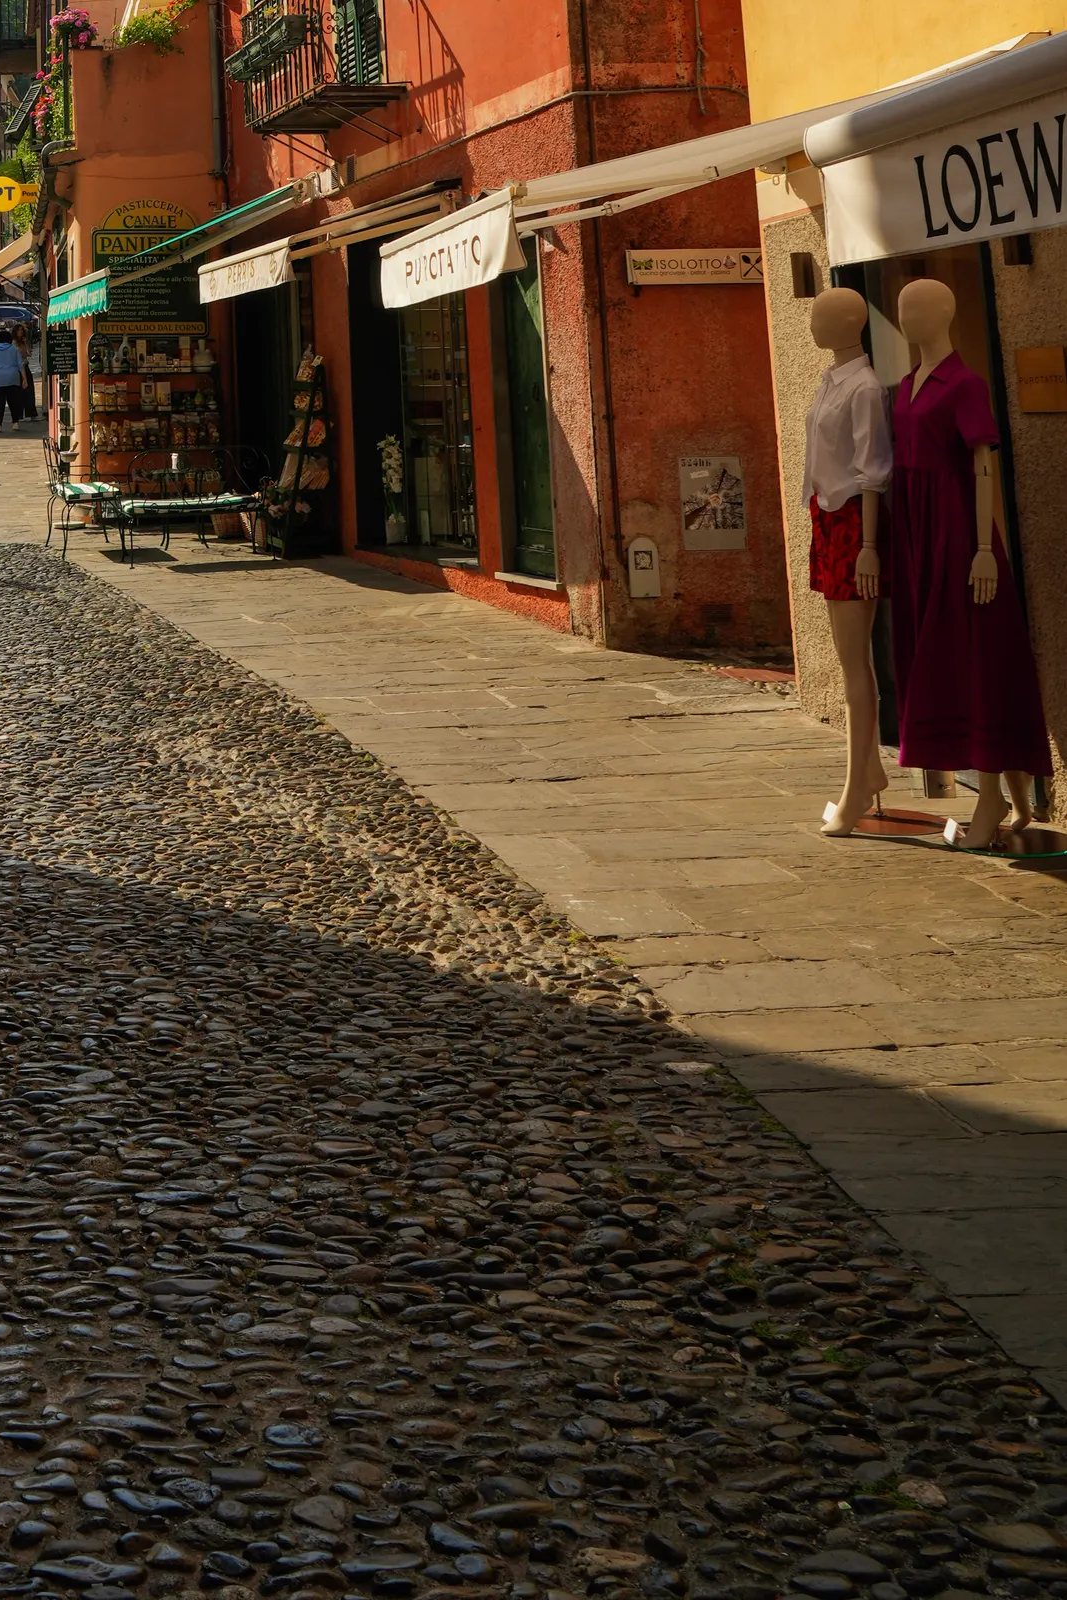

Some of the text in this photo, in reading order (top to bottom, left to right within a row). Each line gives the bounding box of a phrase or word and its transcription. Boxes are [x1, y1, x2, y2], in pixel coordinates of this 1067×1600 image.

[115, 199, 184, 218] PASTICCERIA
[122, 214, 177, 229] CANALE
[655, 258, 722, 270] ISOLOTTO
[227, 260, 255, 285] PERRIS
[140, 287, 171, 295] Formaggio
[99, 324, 204, 332] TUTTO CALDO DAL FORNO
[1018, 375, 1064, 385] PUROTATTO
